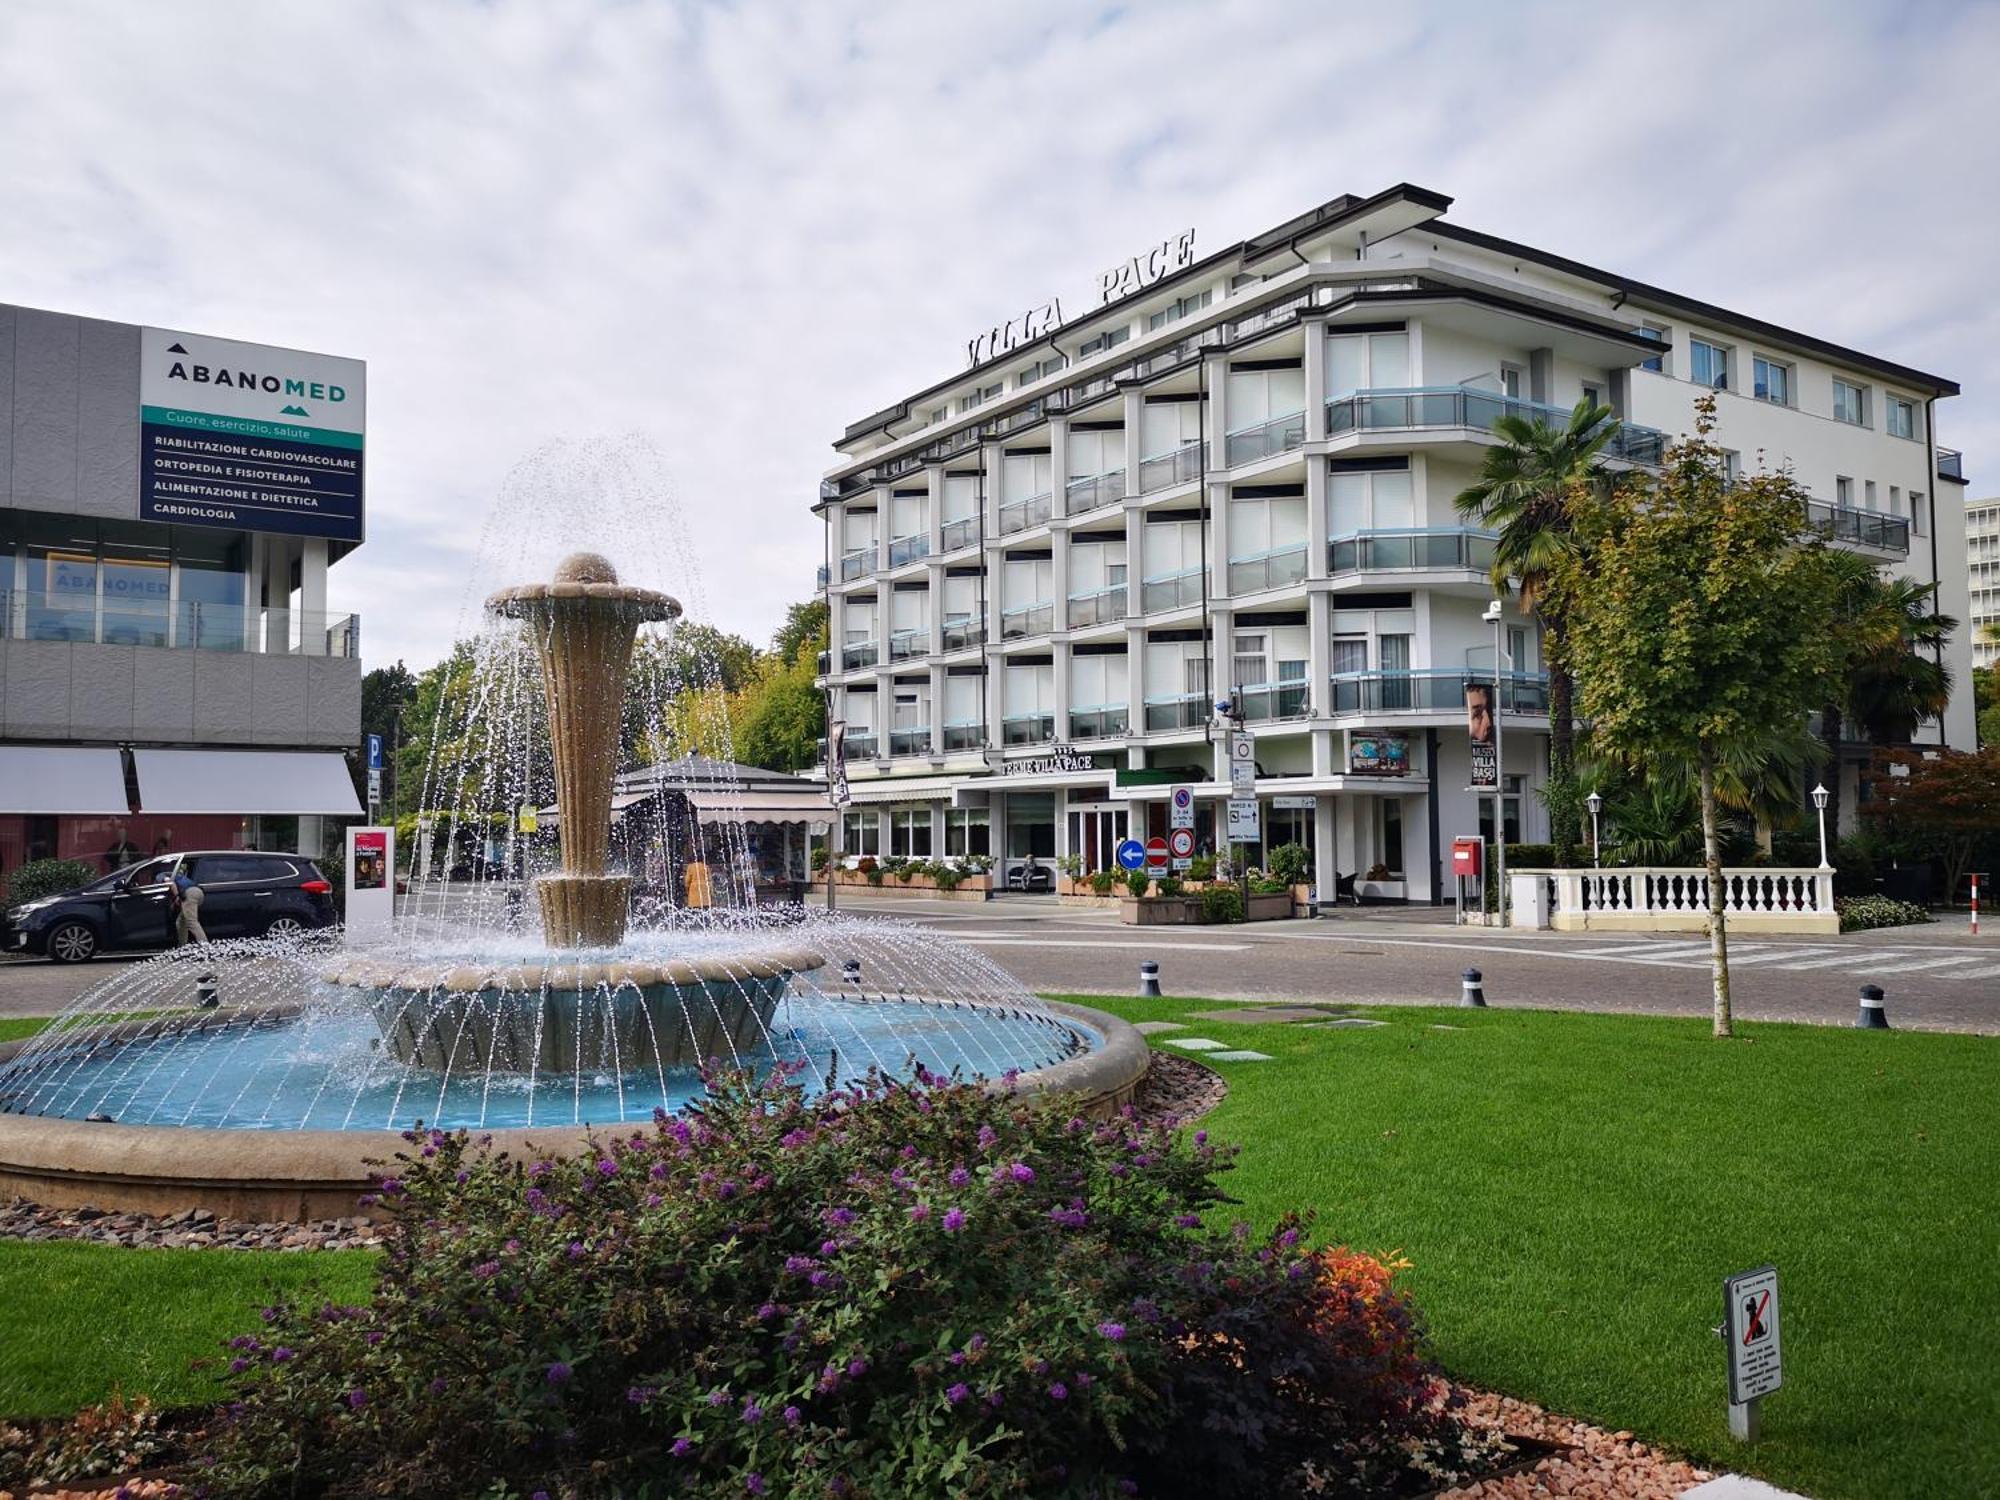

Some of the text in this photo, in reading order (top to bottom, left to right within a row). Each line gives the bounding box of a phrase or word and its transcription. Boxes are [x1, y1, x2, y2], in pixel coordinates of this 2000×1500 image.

[967, 228, 1196, 368] VILLA PACE
[168, 362, 346, 402] ABANOMED
[166, 411, 311, 440] Cuore, esercizio, salute
[155, 436, 357, 469] RIABILITAZIONE CARDIOVASCOLARE
[154, 459, 312, 485] ORTOPEDIA E FISIOTERAPIA
[153, 481, 319, 507] ALIMENTAZIONE E DIETETICA
[153, 504, 236, 520] CARDIOLOGIA
[370, 738, 380, 765] P
[1472, 757, 1496, 768] VILLA
[1002, 755, 1092, 777] TERME VILLA PACE
[1473, 767, 1496, 781] BASSI
